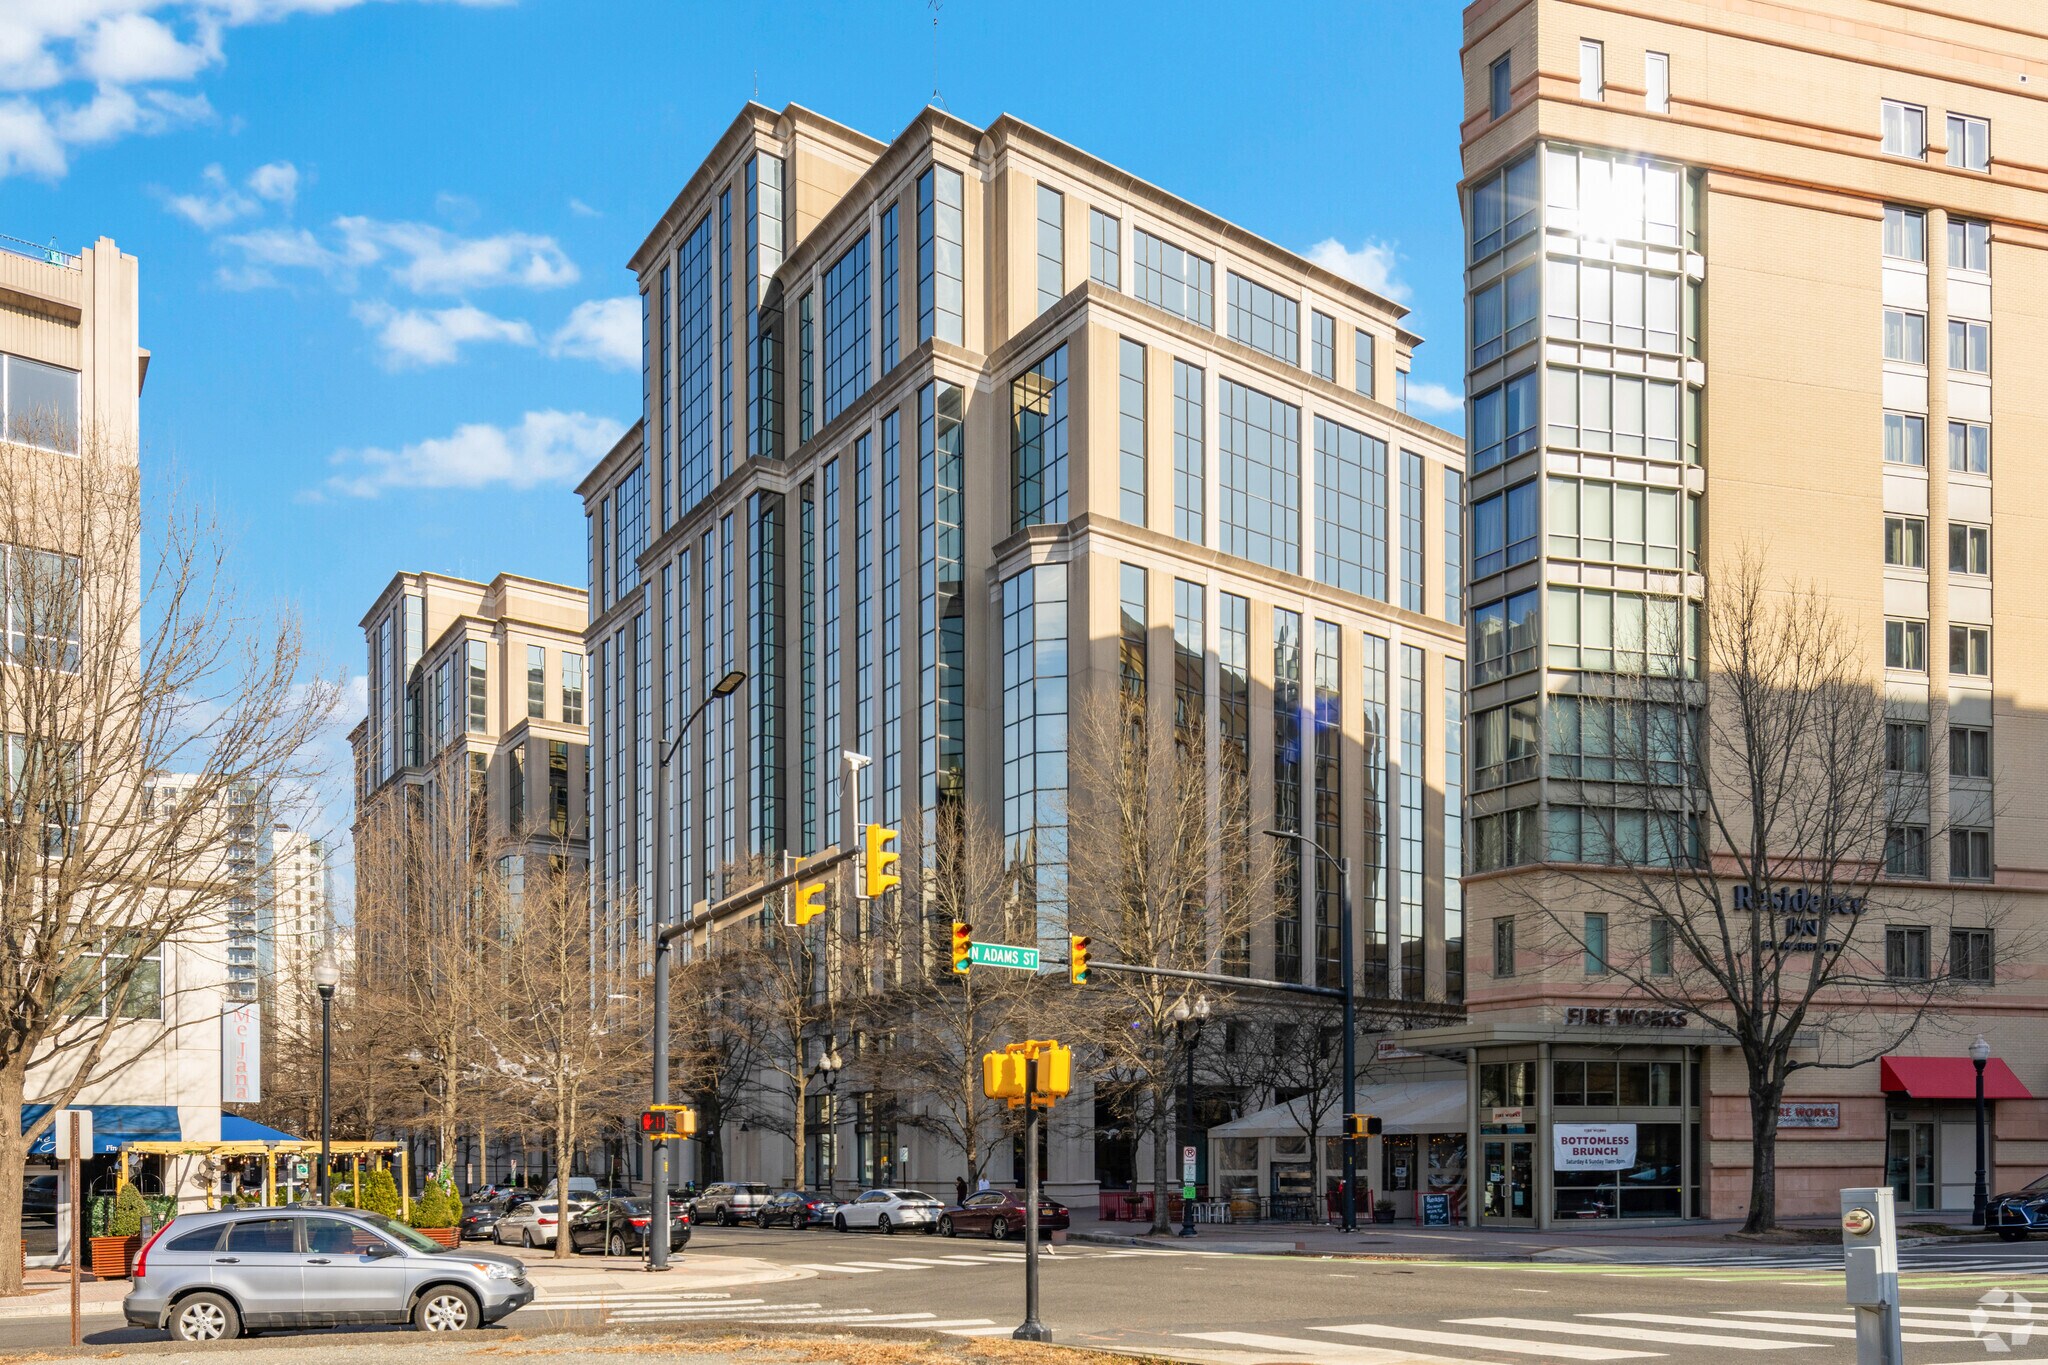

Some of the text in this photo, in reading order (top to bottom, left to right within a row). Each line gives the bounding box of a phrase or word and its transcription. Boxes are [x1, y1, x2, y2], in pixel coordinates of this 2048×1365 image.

[972, 946, 1036, 966] N ADAMS ST
[1564, 1007, 1688, 1028] FIRE WORKS
[1795, 1107, 1836, 1117] WORKS
[1561, 1136, 1629, 1145] BOTTOMLESS
[105, 1144, 119, 1152] Fin
[1572, 1147, 1619, 1156] BRUNCH
